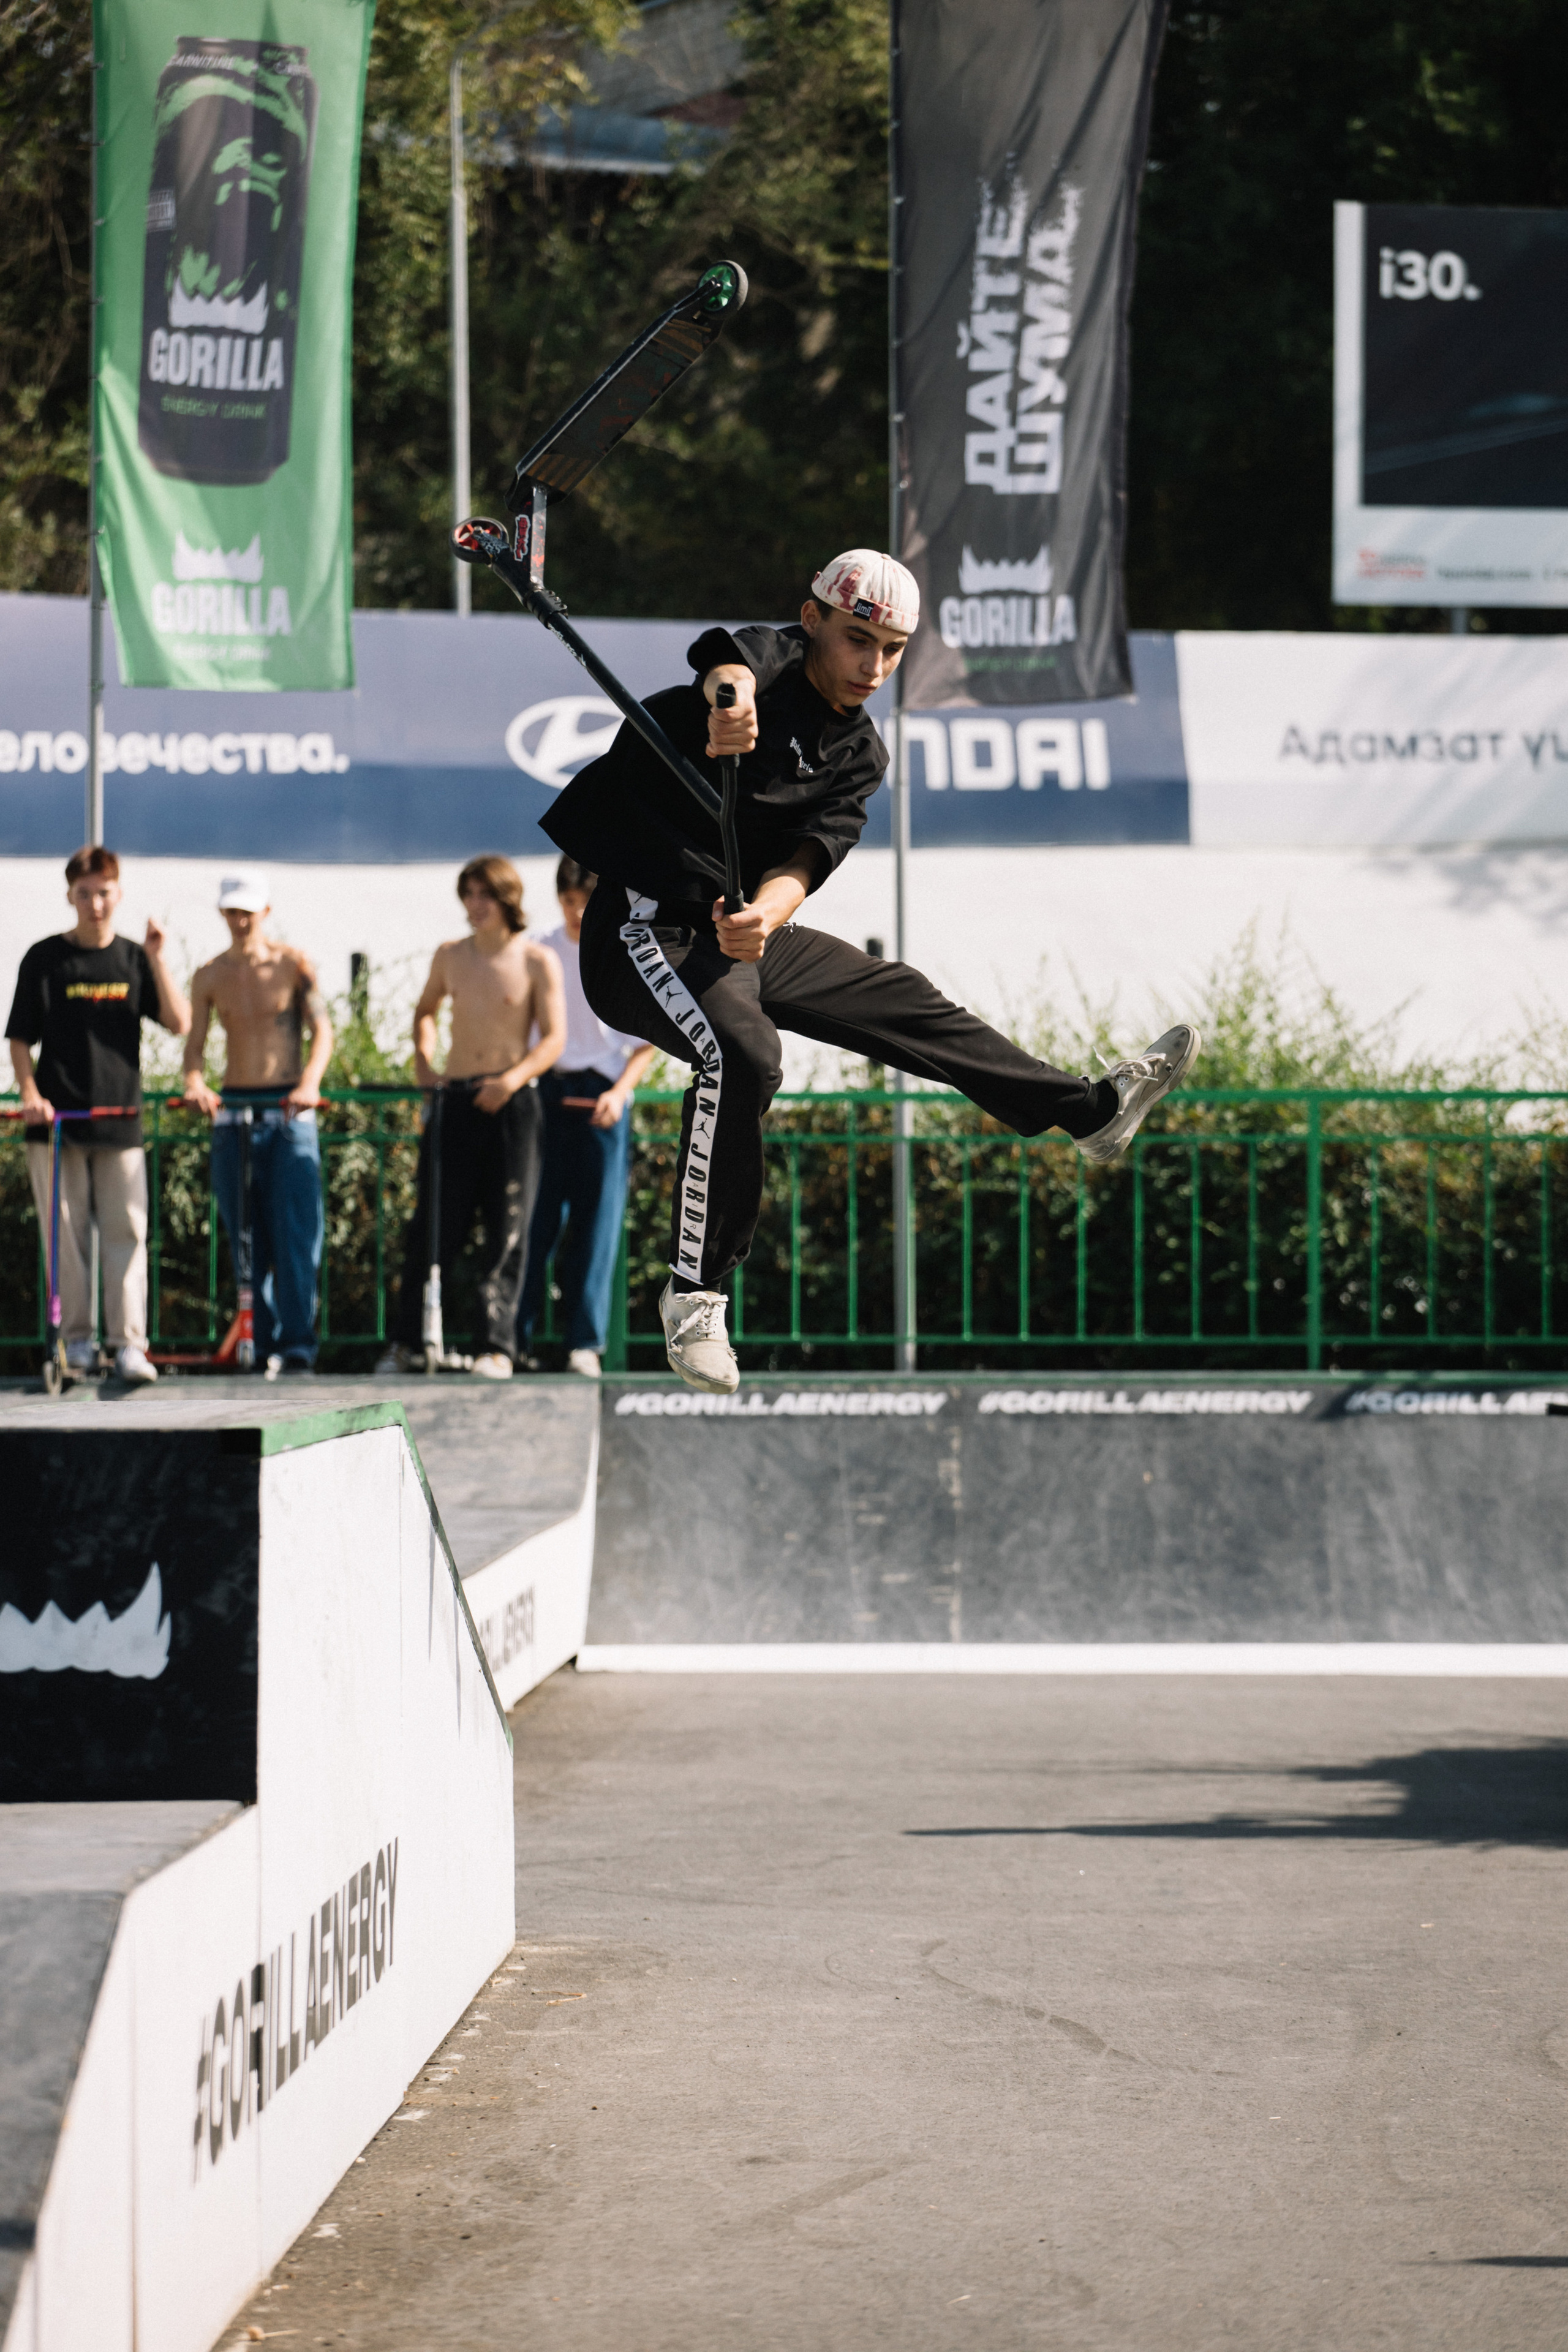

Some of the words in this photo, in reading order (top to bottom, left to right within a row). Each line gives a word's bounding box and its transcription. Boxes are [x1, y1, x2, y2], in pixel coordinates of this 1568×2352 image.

[1379, 247, 1482, 301] i30.
[148, 328, 284, 391] GORILLA
[151, 582, 292, 638] GORILLA
[940, 594, 1077, 649] GORILLA
[872, 717, 1112, 791] NDAI
[675, 1008, 720, 1117] JORDAN
[678, 1142, 709, 1270] JORDAN
[978, 1390, 1314, 1415] #GORILLAENERGY
[192, 1836, 398, 2187] #GORILLAENERGY
